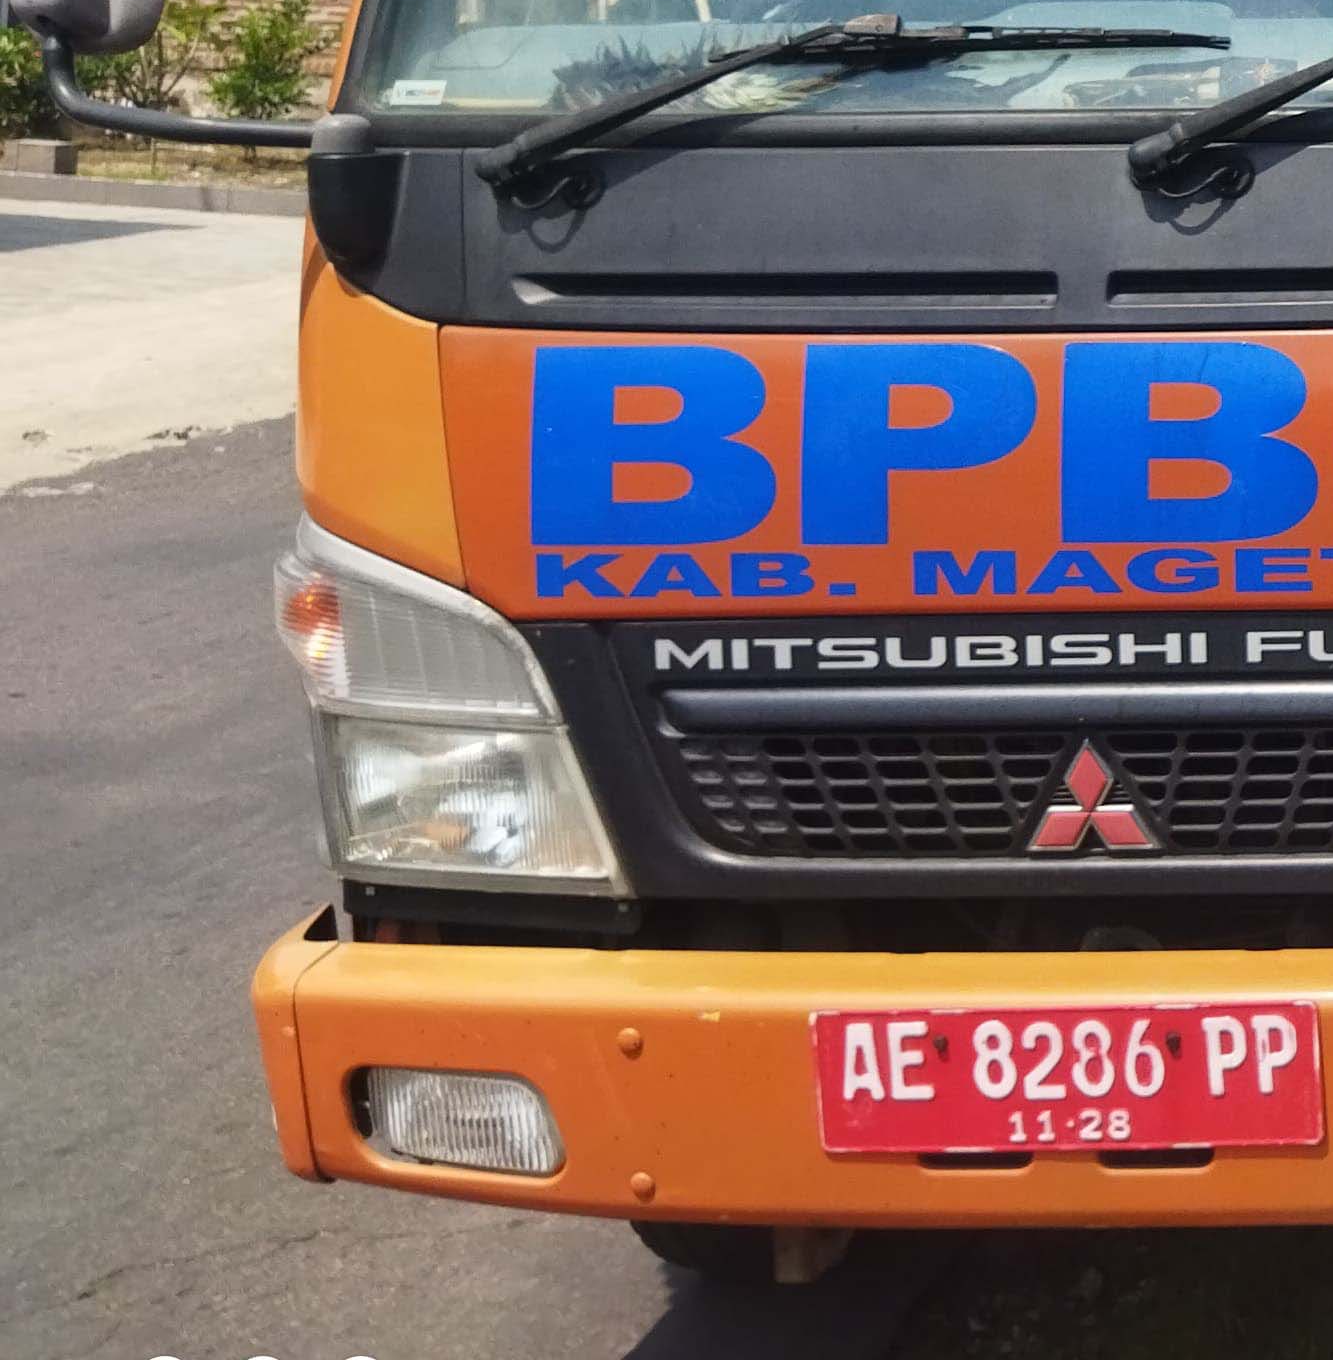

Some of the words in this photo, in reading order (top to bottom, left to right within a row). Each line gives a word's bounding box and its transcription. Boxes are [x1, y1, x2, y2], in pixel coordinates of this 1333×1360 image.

[536, 553, 857, 597] KAB.
[654, 630, 1207, 671] MITSUBISHI
[843, 1020, 935, 1101] AE
[972, 1018, 1166, 1100] 8286
[1202, 1014, 1299, 1097] PP
